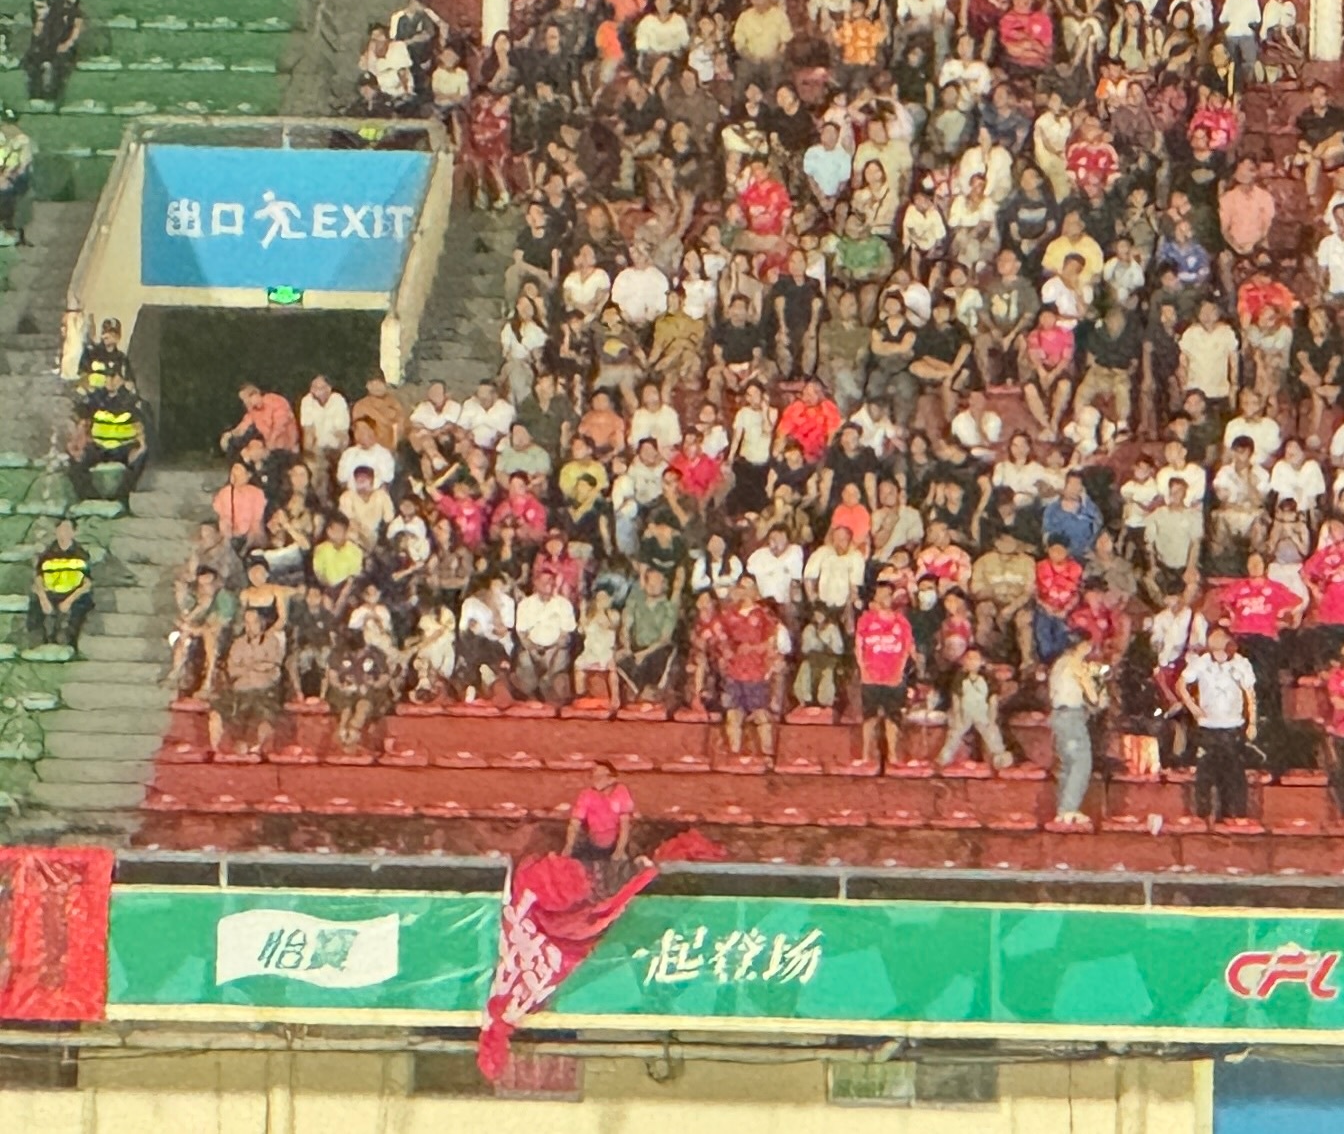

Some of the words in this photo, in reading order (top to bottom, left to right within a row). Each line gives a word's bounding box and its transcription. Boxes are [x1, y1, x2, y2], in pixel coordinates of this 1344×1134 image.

[166, 199, 245, 238] 出口
[312, 203, 415, 239] EXIT
[1226, 944, 1343, 1000] CFL
